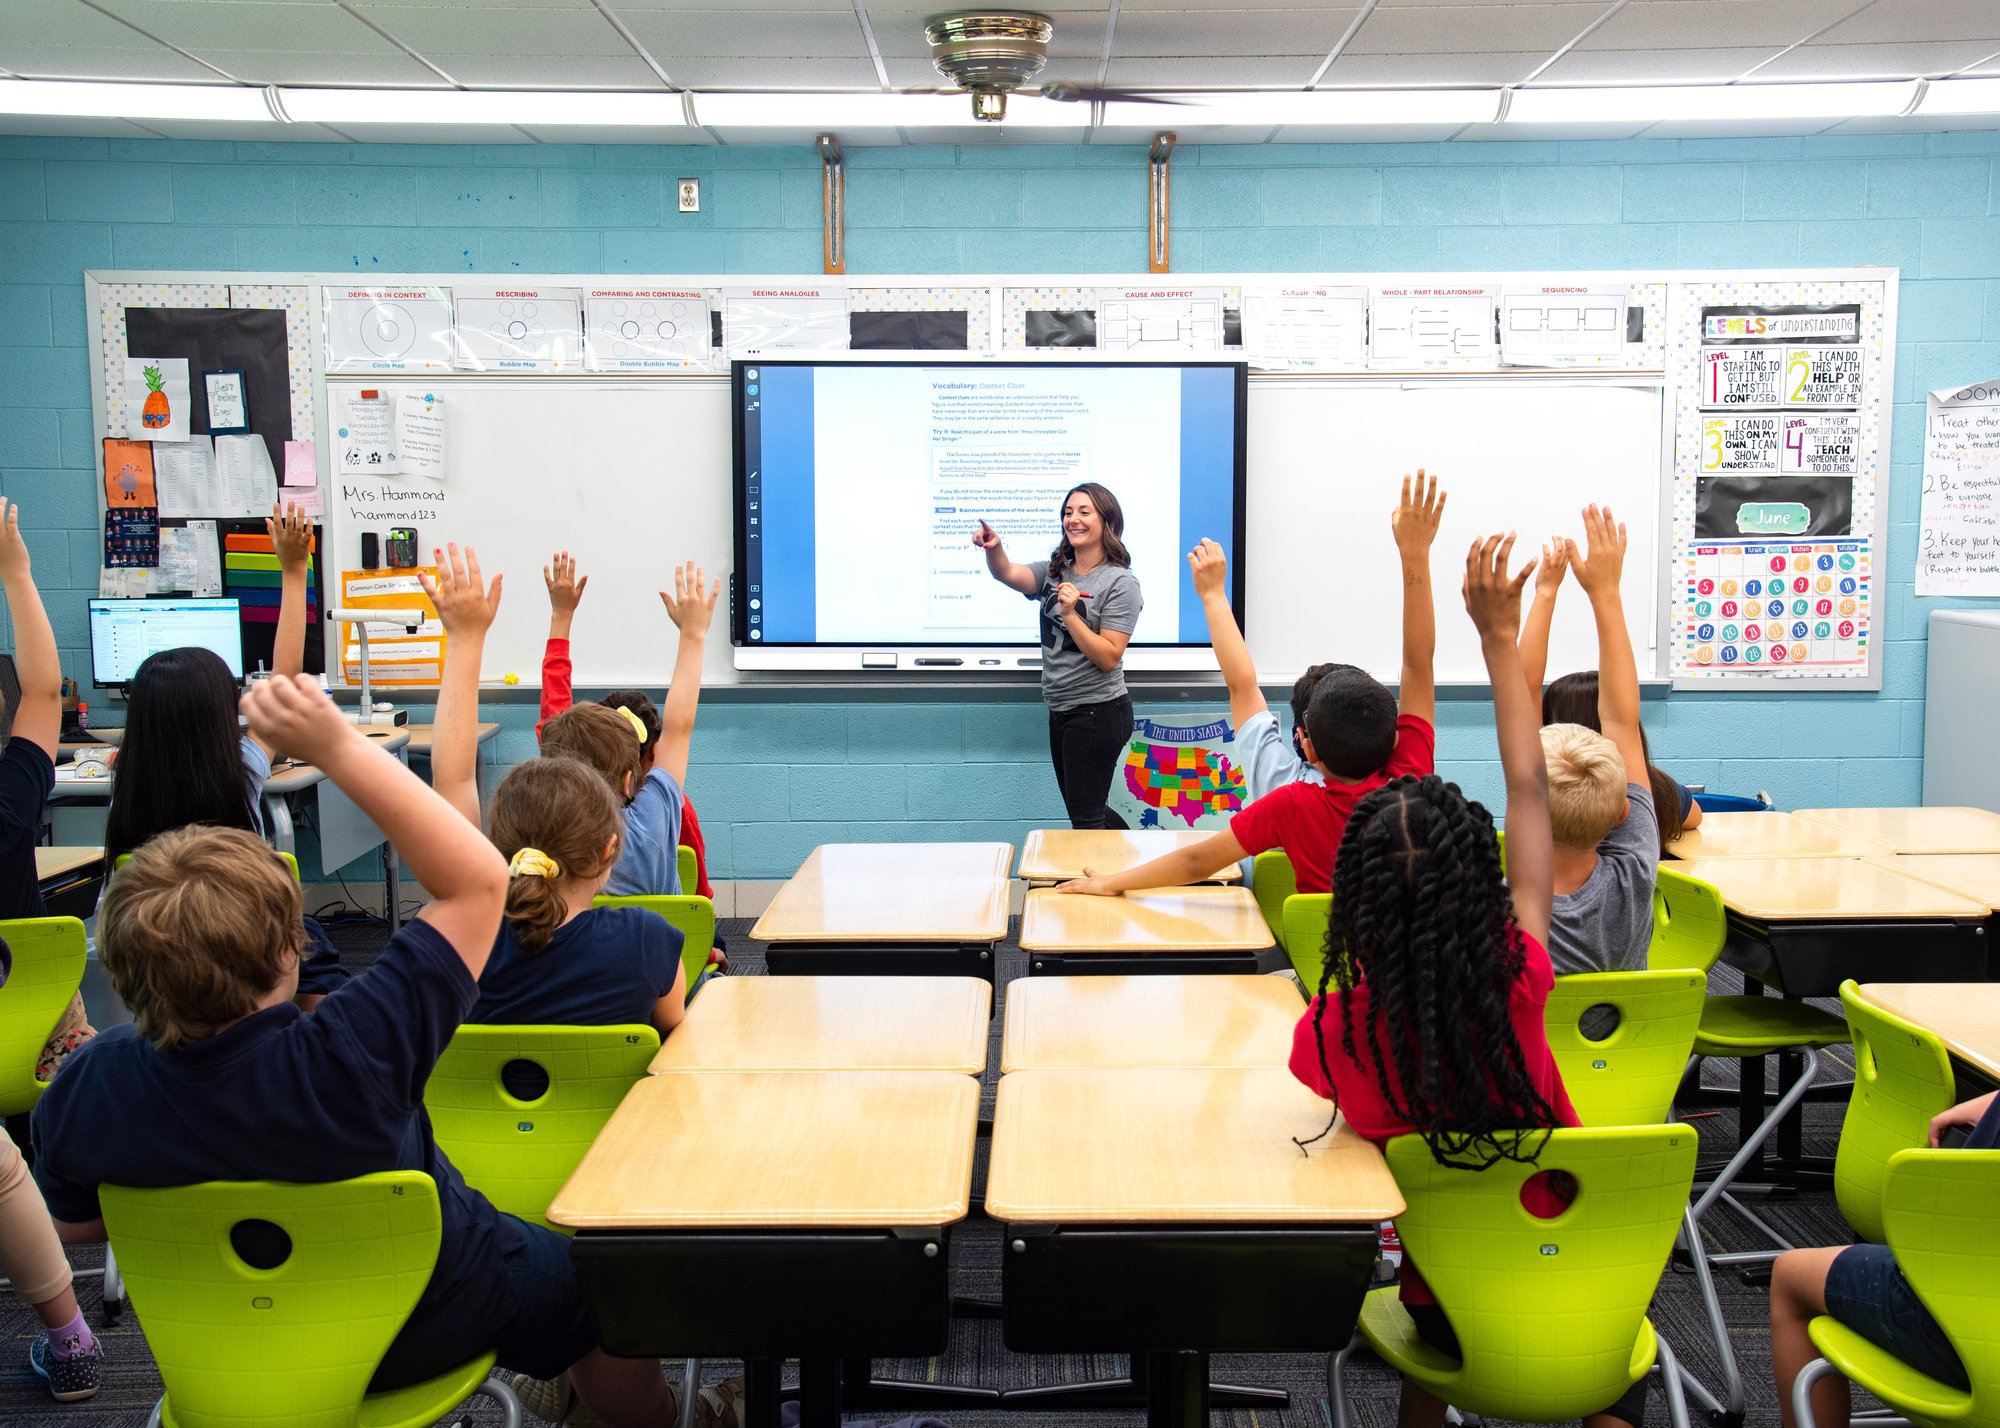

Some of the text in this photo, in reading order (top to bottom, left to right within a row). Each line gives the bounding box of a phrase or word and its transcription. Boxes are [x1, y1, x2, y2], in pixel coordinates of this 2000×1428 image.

[1707, 317, 1853, 334] LEVELS of UNDERSTANDING
[1707, 352, 1729, 362] LEVEL
[1751, 351, 1764, 360] AM
[1789, 351, 1812, 361] LEVEL
[1825, 351, 1858, 361] CAN DO
[392, 362, 405, 370] Map
[1723, 361, 1780, 372] STARTING TO
[1812, 362, 1860, 372] THIS WITH
[1728, 372, 1776, 383] GET BUT
[1788, 359, 1810, 402] 2
[1813, 373, 1860, 383] HELP OR
[1735, 383, 1775, 393] AM STILL
[1803, 384, 1861, 393] AN EXAMPLE IN
[1724, 394, 1779, 403] CONFUSED.
[1806, 393, 1860, 403] FRONT OF ME.
[1704, 420, 1727, 430] LEVEL
[1741, 420, 1773, 430] CAN DO
[1786, 419, 1808, 429] LEVEL
[1820, 418, 1849, 426] I'M VERY
[1937, 413, 1969, 428] Treat
[1724, 430, 1778, 440] THIS ON MY
[1804, 427, 1859, 435] CONFIDENT WITH
[1838, 435, 1853, 444] CAN
[1939, 431, 1980, 442] how you
[1705, 429, 1723, 470] 3
[1725, 440, 1777, 450] OWN. CAN
[1786, 429, 1803, 468] 4
[1814, 445, 1850, 455] TEACH
[1937, 440, 2000, 450] to be treated
[1735, 450, 1761, 461] SHOW
[1806, 455, 1856, 463] SOMEONE HOW
[1812, 464, 1821, 472] TO
[1822, 464, 1832, 472] DO
[1923, 474, 1935, 494] 2.
[1940, 474, 1959, 491] Be
[343, 486, 445, 503] Mrs. Hammond
[1944, 493, 1992, 504] to everyone
[1756, 509, 1791, 525] June
[1924, 529, 1989, 550] 3. Keep your
[1926, 550, 1945, 560] feet
[1964, 551, 1995, 562] yourself
[1822, 558, 1829, 567] 3
[1925, 564, 1961, 576] (Respect
[1702, 582, 1709, 592] 5
[1750, 583, 1757, 593] 7
[1773, 582, 1781, 592] 8
[1798, 580, 1805, 591] 9
[1819, 580, 1827, 589] 10
[1844, 581, 1852, 591] 11
[1699, 604, 1707, 614] 12
[1725, 604, 1734, 614] 13
[1771, 603, 1781, 614] 15
[1797, 602, 1805, 613] 16
[1820, 603, 1828, 613] 17
[1844, 603, 1853, 612] 18
[1702, 626, 1711, 637] 19
[1726, 626, 1736, 638] 20
[1749, 627, 1758, 639] 21
[1794, 623, 1806, 635] 23
[1818, 625, 1827, 636] 24
[1841, 623, 1852, 634] 25
[1724, 648, 1734, 659] 27
[1749, 649, 1759, 660] 28
[1773, 647, 1784, 659] 29
[1794, 648, 1804, 657] 30
[1152, 723, 1224, 741] THE UNITED STATES
[1542, 1246, 1557, 1255] VS
